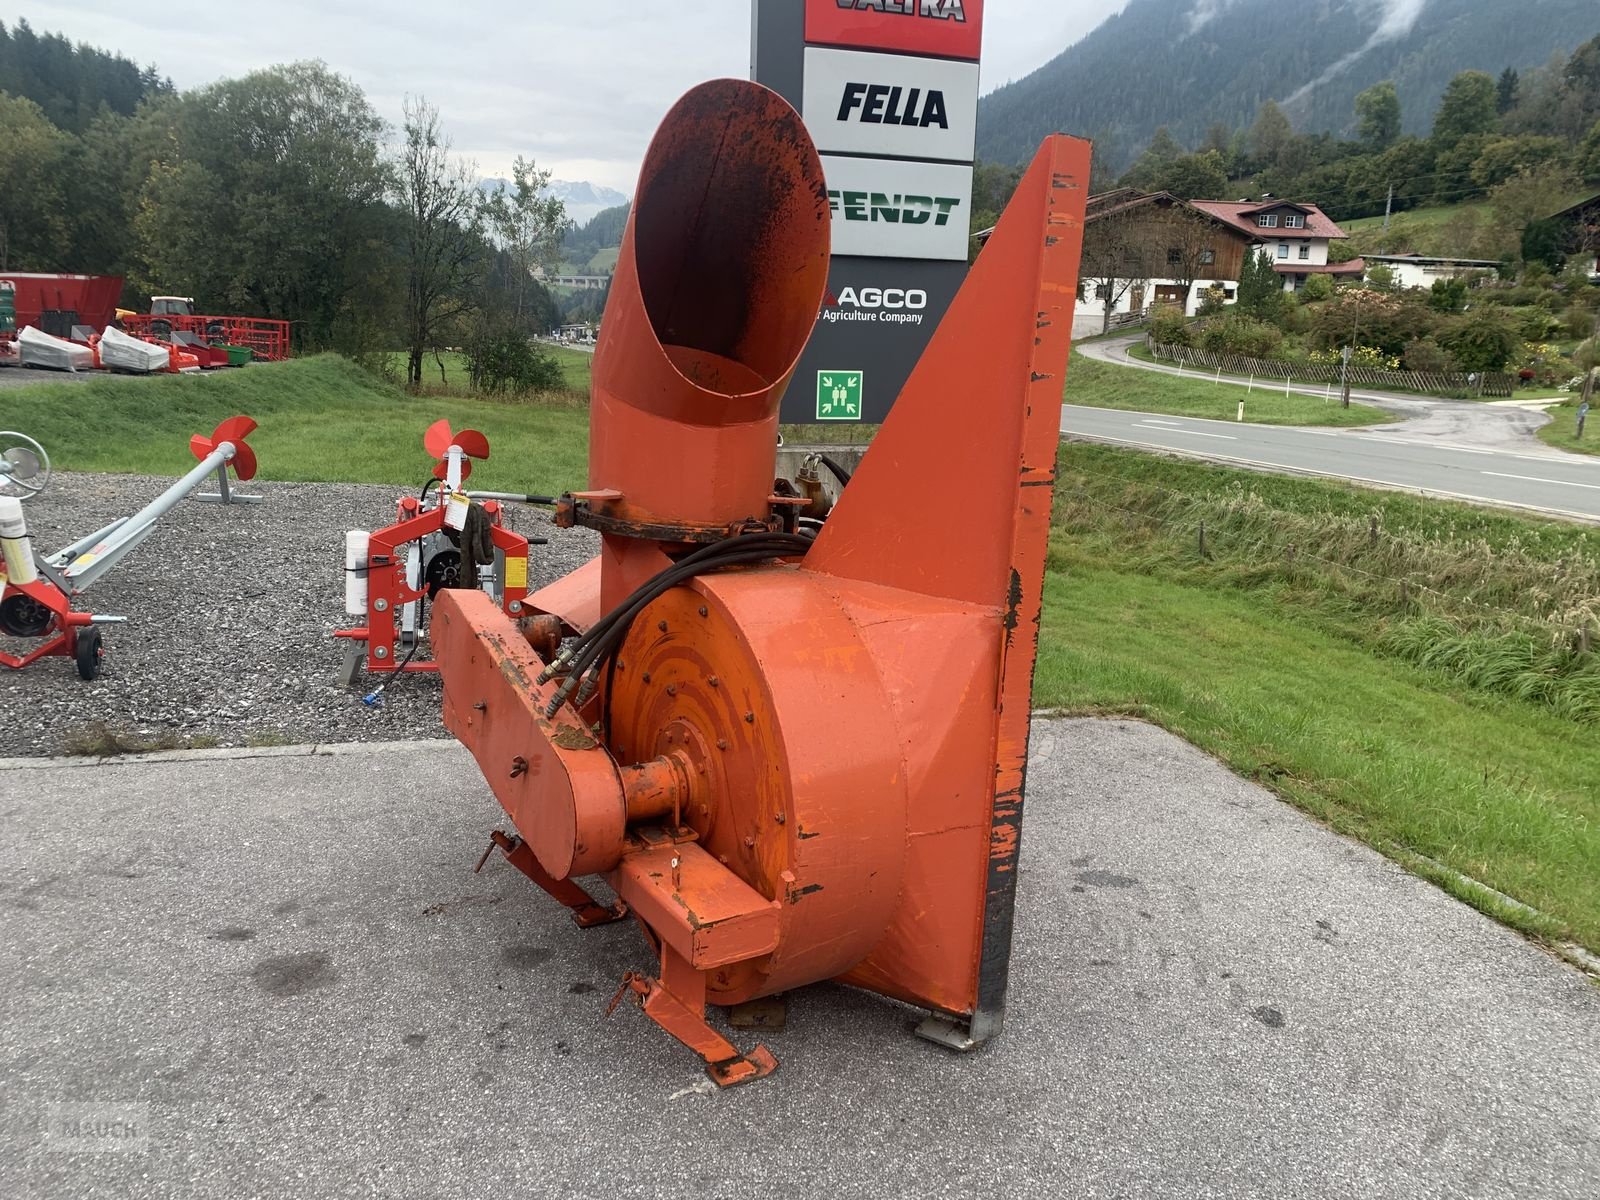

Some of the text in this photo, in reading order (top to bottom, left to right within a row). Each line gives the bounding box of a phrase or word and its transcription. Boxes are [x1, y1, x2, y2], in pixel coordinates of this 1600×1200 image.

[836, 82, 949, 130] FELLA
[837, 286, 928, 309] AGCO
[823, 309, 877, 323] Agriculture
[879, 311, 923, 325] Company
